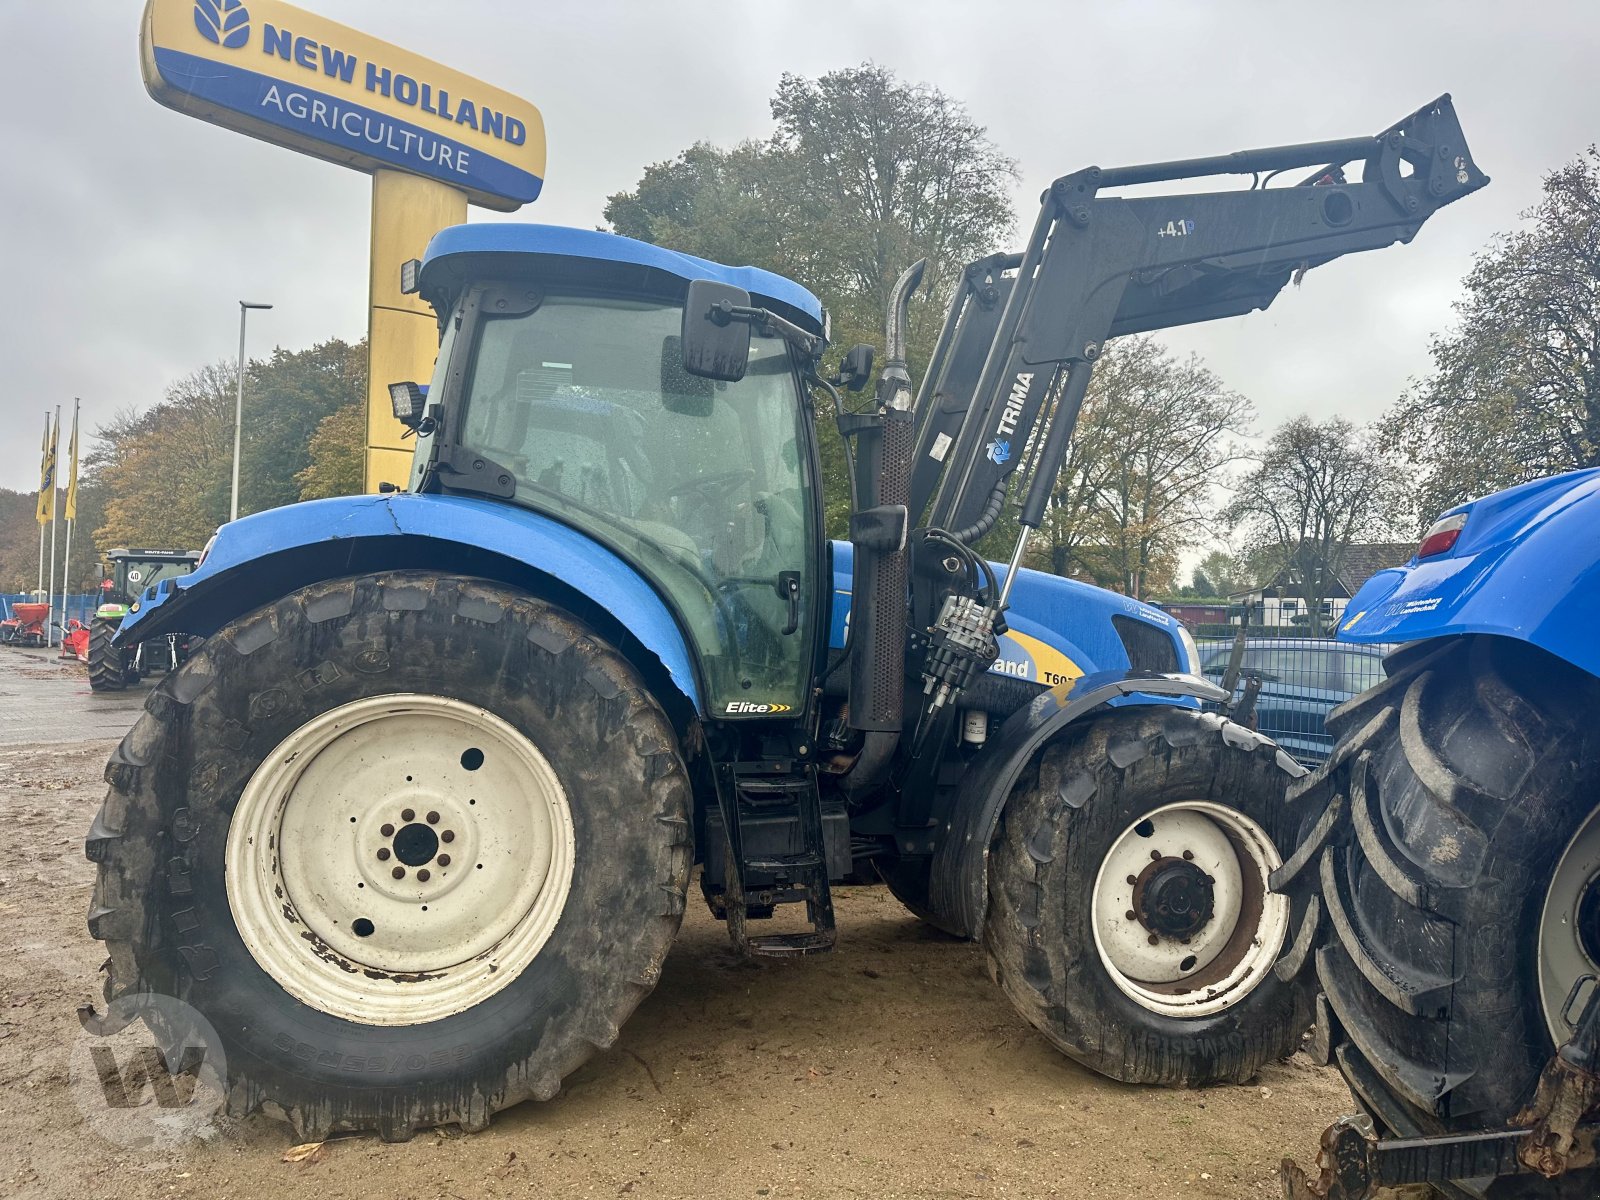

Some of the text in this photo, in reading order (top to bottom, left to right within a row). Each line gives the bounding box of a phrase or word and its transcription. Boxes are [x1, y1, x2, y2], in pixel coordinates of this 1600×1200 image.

[263, 23, 527, 147] NEW HOLLAND
[260, 85, 471, 175] AGRICULTURE
[996, 372, 1035, 436] TRIMA
[130, 572, 139, 581] 40
[988, 658, 1029, 678] and
[1044, 671, 1074, 685] T60
[725, 701, 768, 713] Elite
